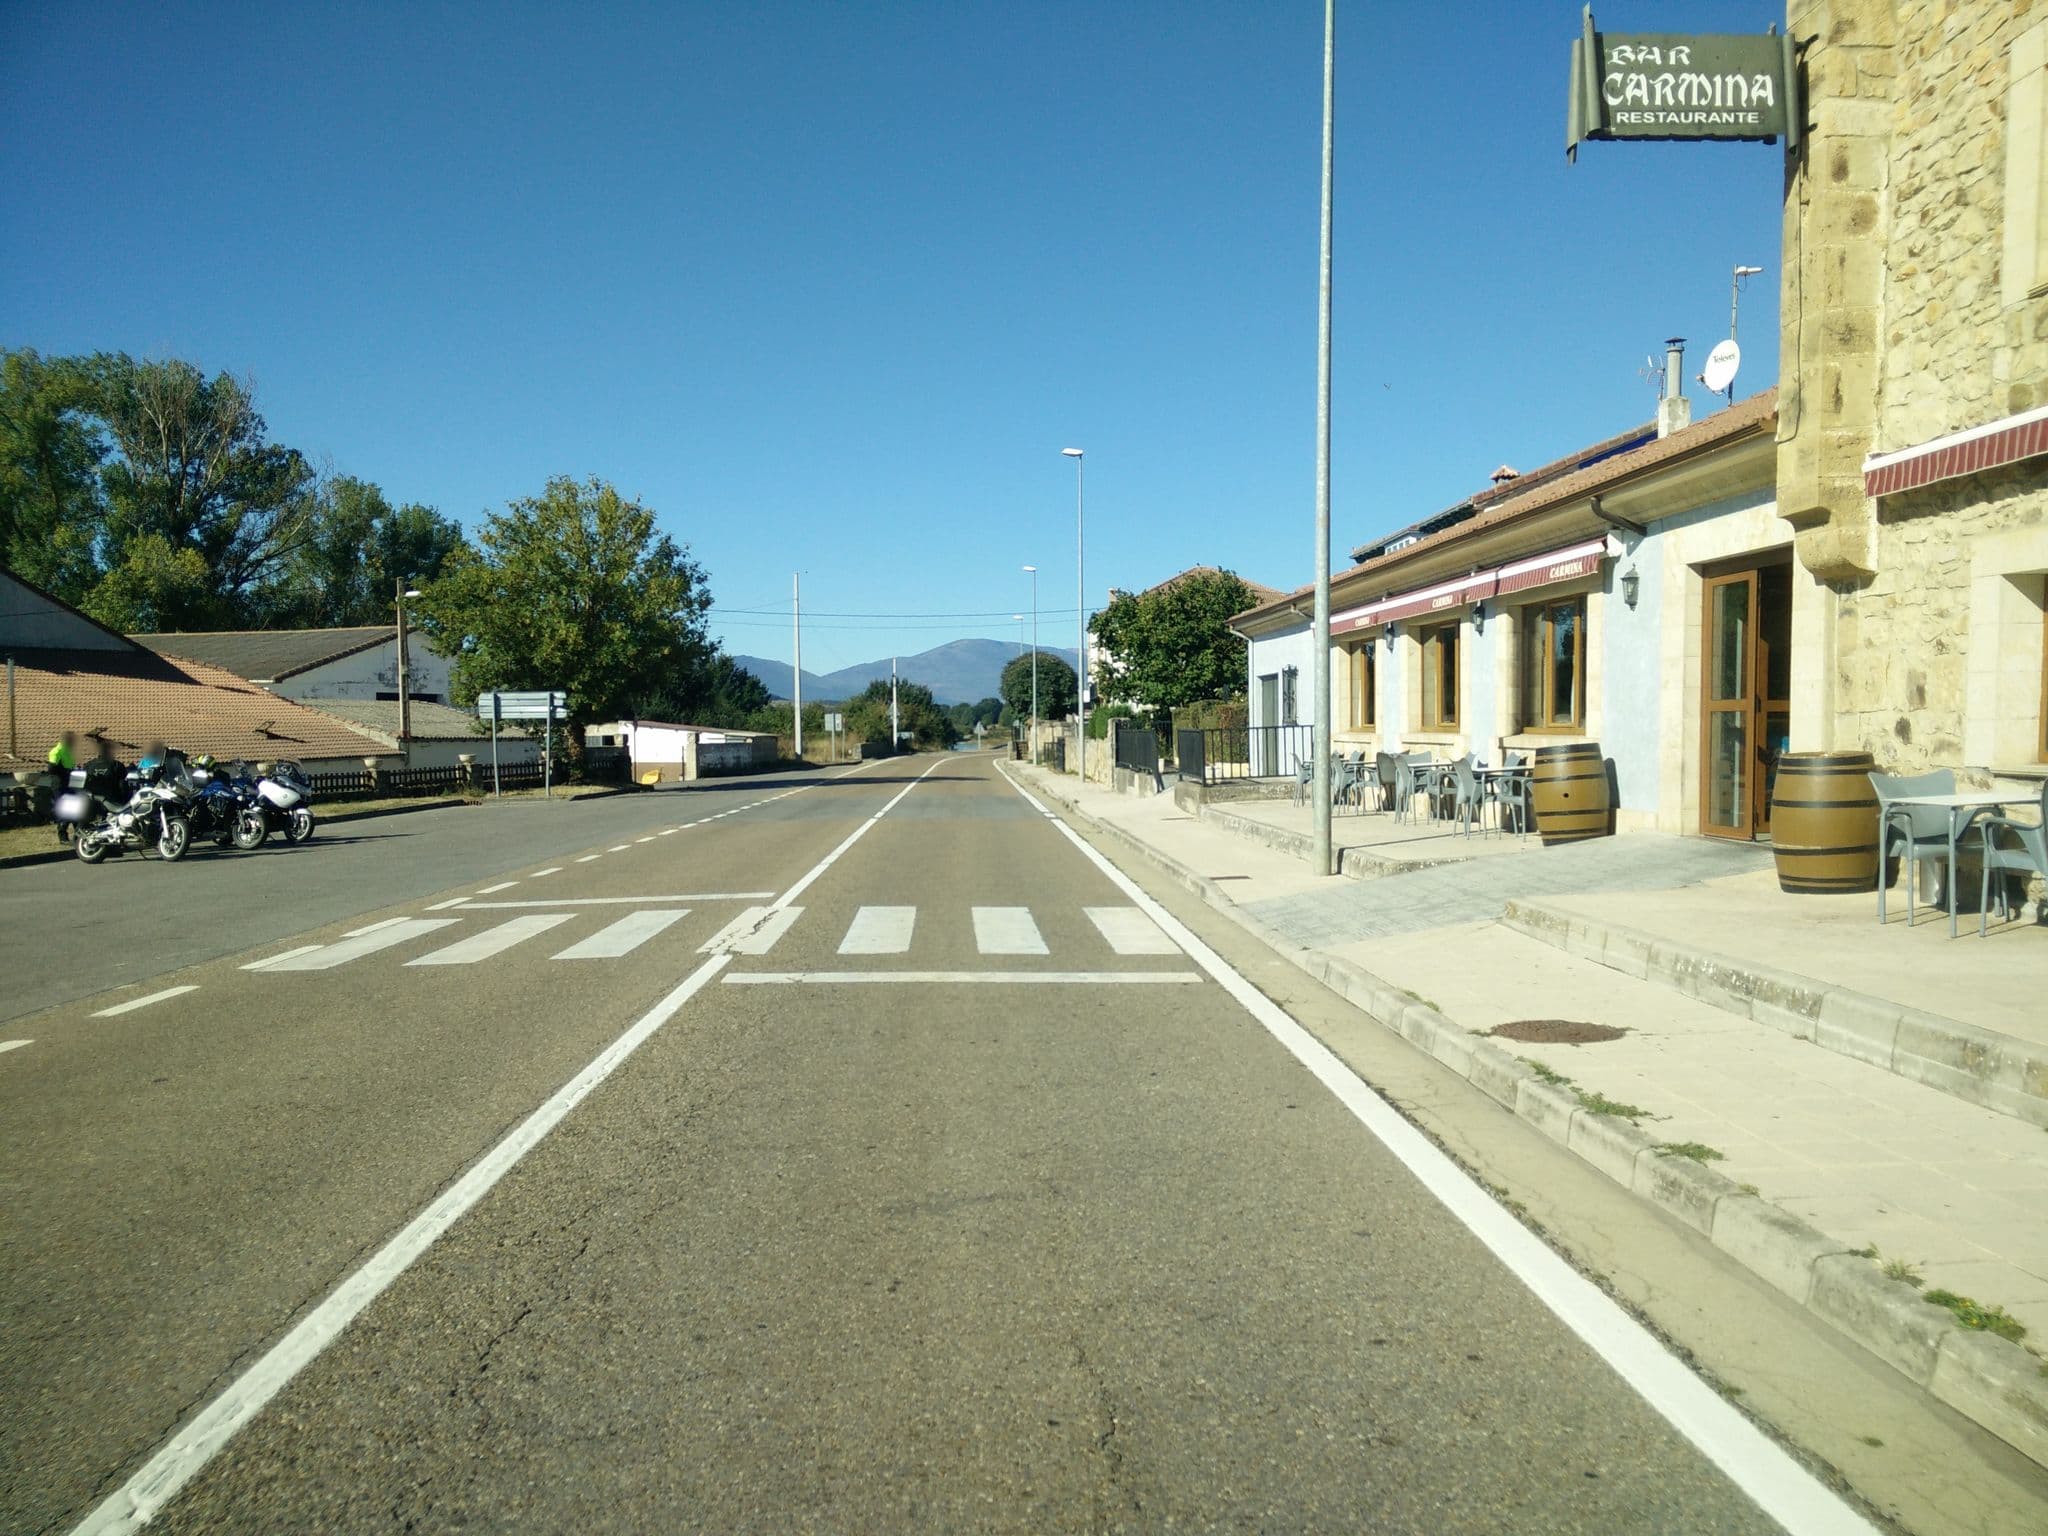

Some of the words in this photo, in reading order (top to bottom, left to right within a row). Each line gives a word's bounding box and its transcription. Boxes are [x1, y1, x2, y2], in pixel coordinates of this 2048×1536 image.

[1607, 45, 1691, 65] BAR
[1602, 72, 1775, 107] CARMINA
[1616, 111, 1760, 124] RESTAURANTE
